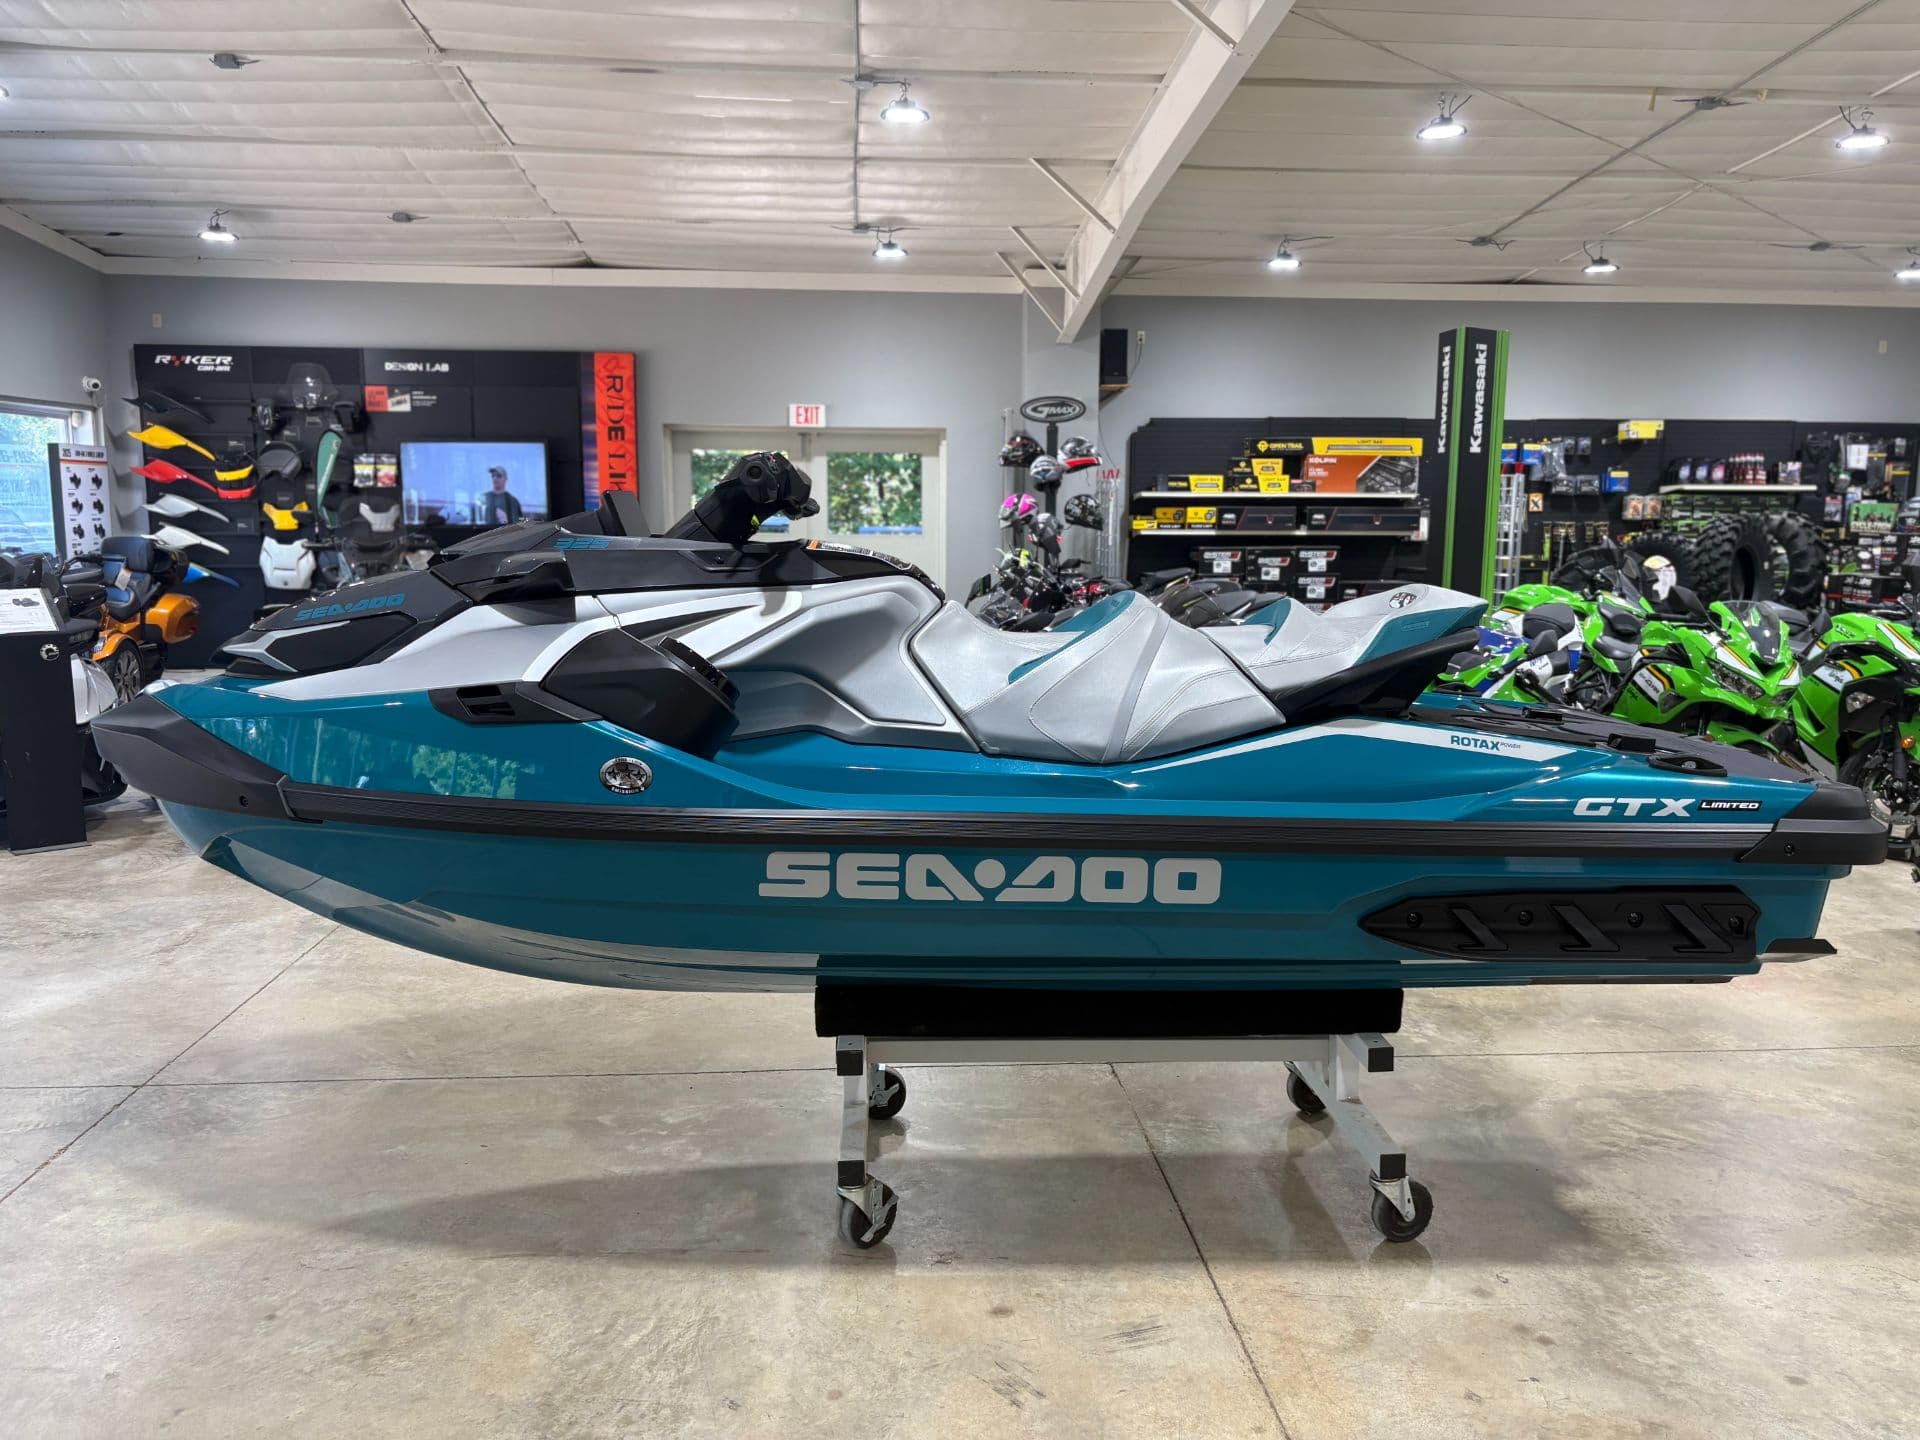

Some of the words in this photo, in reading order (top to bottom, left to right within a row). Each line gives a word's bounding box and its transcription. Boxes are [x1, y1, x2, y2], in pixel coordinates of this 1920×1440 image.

[154, 354, 233, 367] RYKER
[384, 361, 423, 372] DESIGN
[426, 362, 449, 373] LAB
[1438, 345, 1451, 453] Kawasaki
[1469, 343, 1488, 453] Kawasaki
[796, 405, 820, 425] EXIT
[1026, 401, 1080, 418] GMAX
[1269, 442, 1287, 450] OPEN
[1287, 442, 1304, 450] TRAIL
[1450, 735, 1501, 751] ROTAX
[1573, 797, 1696, 817] GTX
[1701, 801, 1760, 809] LIMITED
